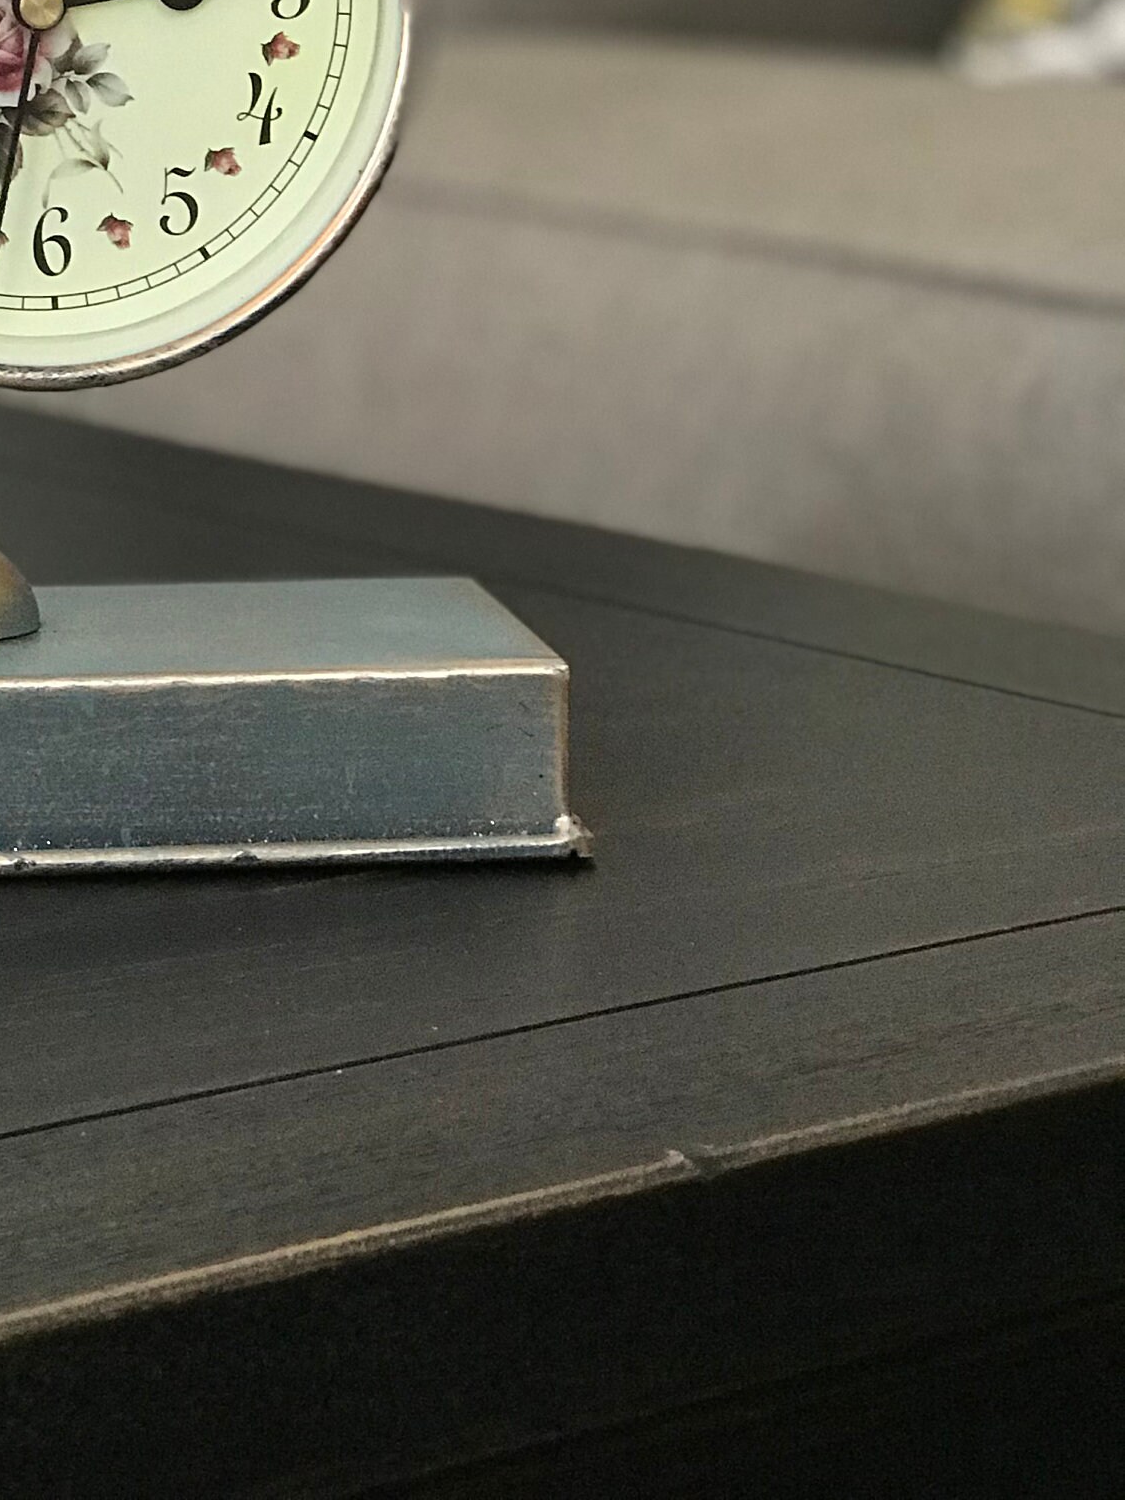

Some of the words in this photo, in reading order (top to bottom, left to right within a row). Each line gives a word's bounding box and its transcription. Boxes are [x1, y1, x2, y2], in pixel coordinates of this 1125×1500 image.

[236, 72, 283, 146] 4
[159, 167, 199, 236] 5
[32, 207, 72, 277] 6
